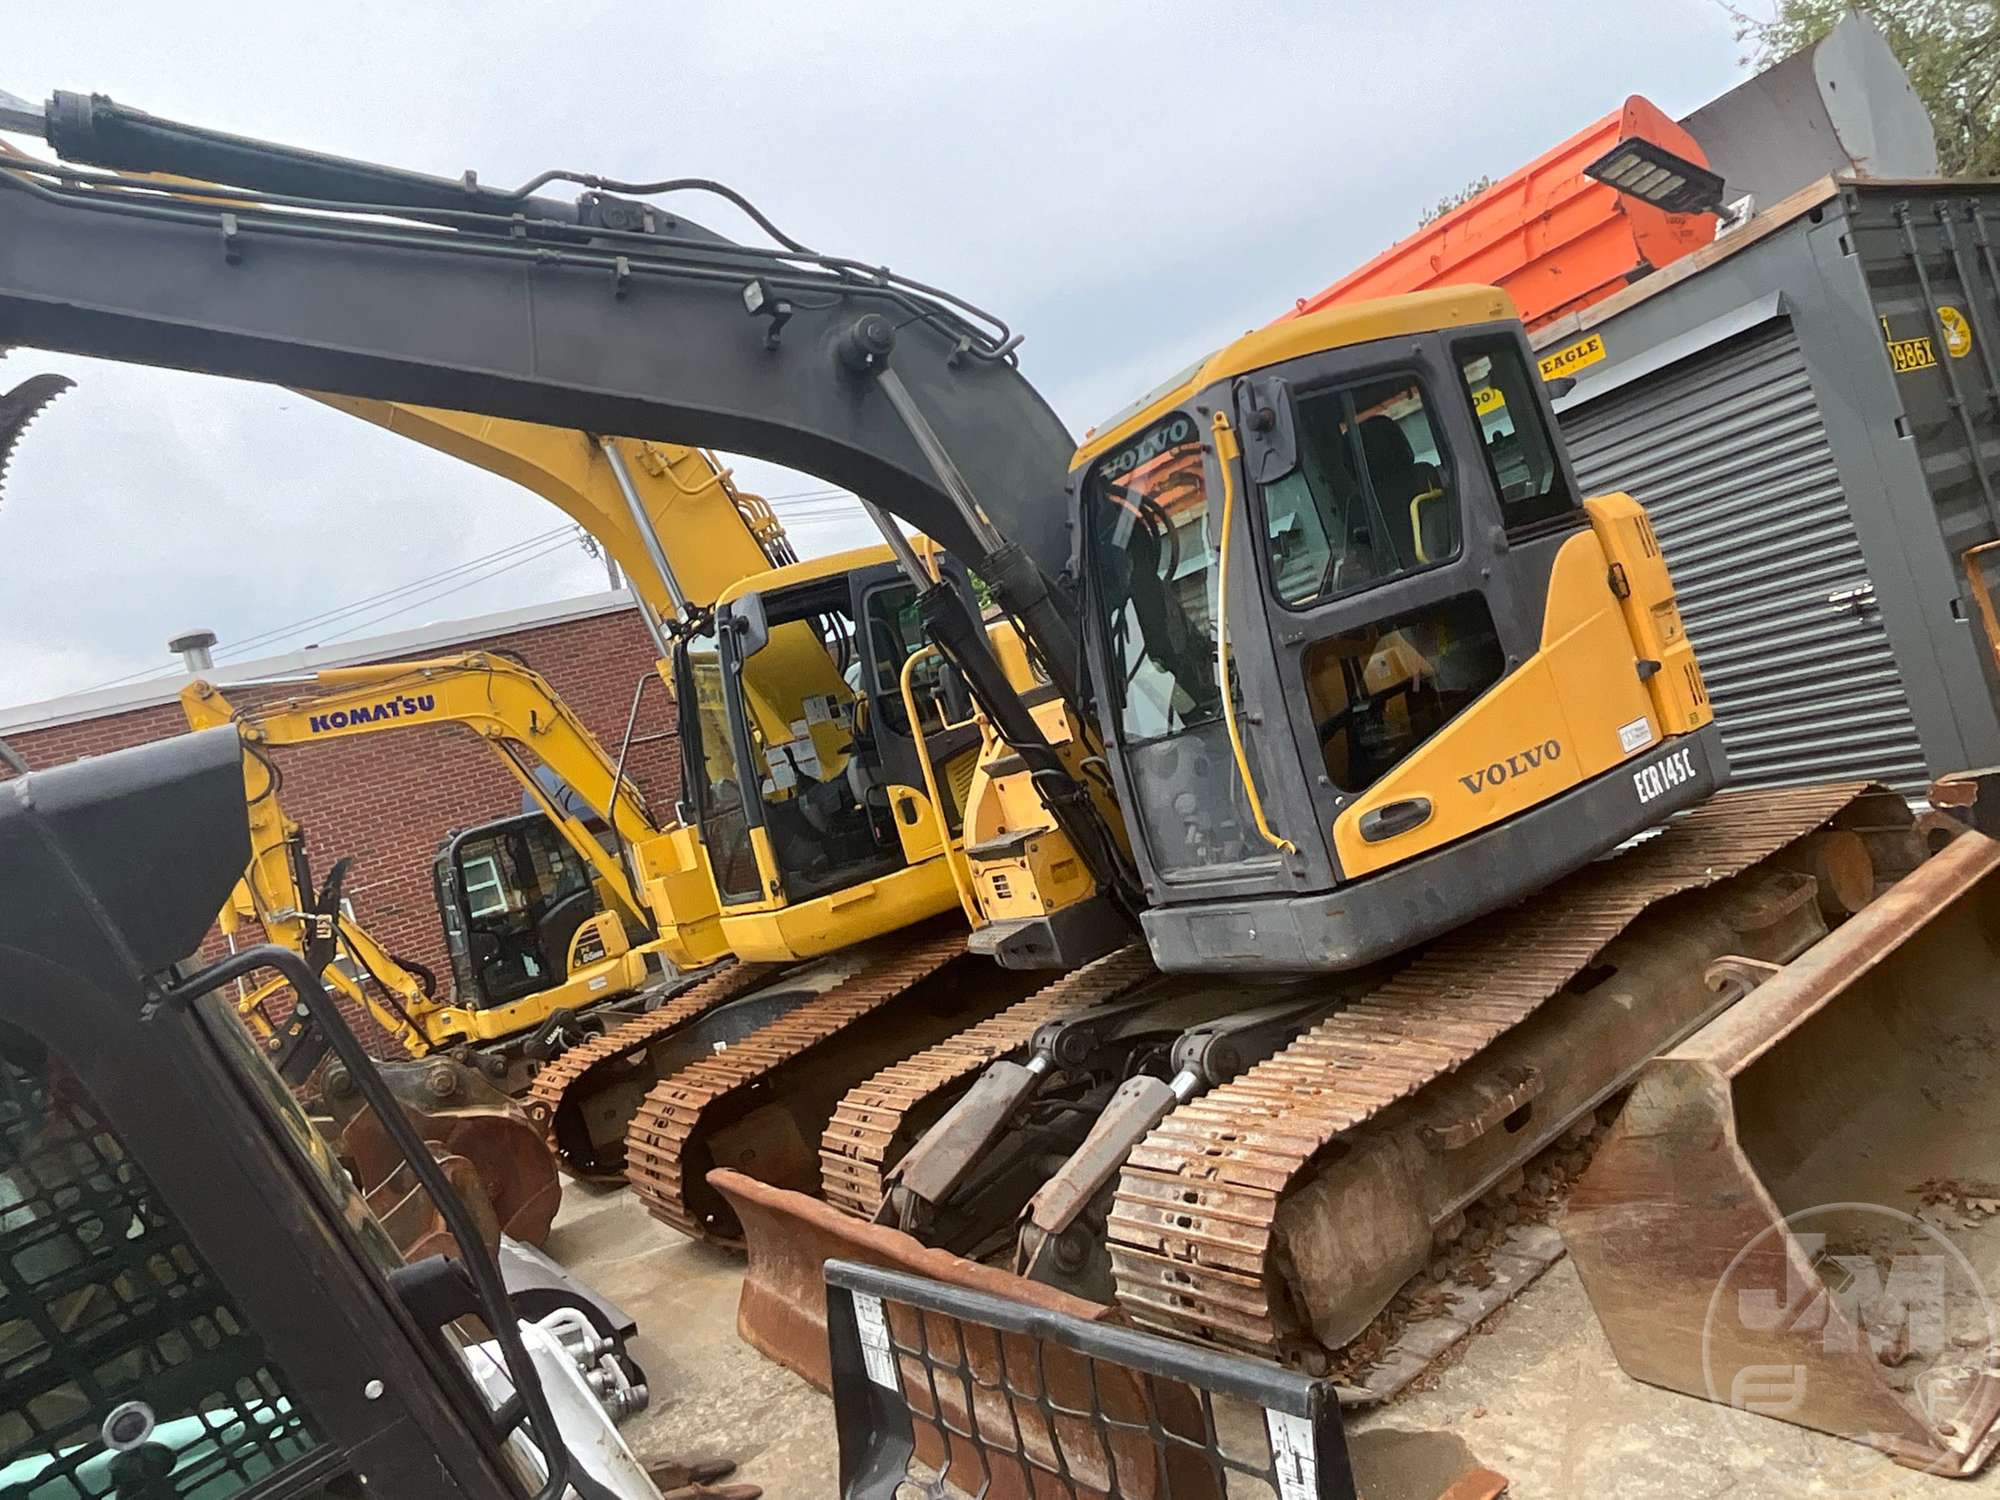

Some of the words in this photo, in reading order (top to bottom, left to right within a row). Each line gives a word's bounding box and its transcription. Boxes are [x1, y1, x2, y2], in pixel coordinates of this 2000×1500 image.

[1541, 339, 1599, 374] EAGLE
[1099, 419, 1189, 480] VOLVO
[309, 695, 435, 733] KOMATSU
[1458, 739, 1561, 794] VOLVO
[1633, 748, 1696, 804] ECR145C
